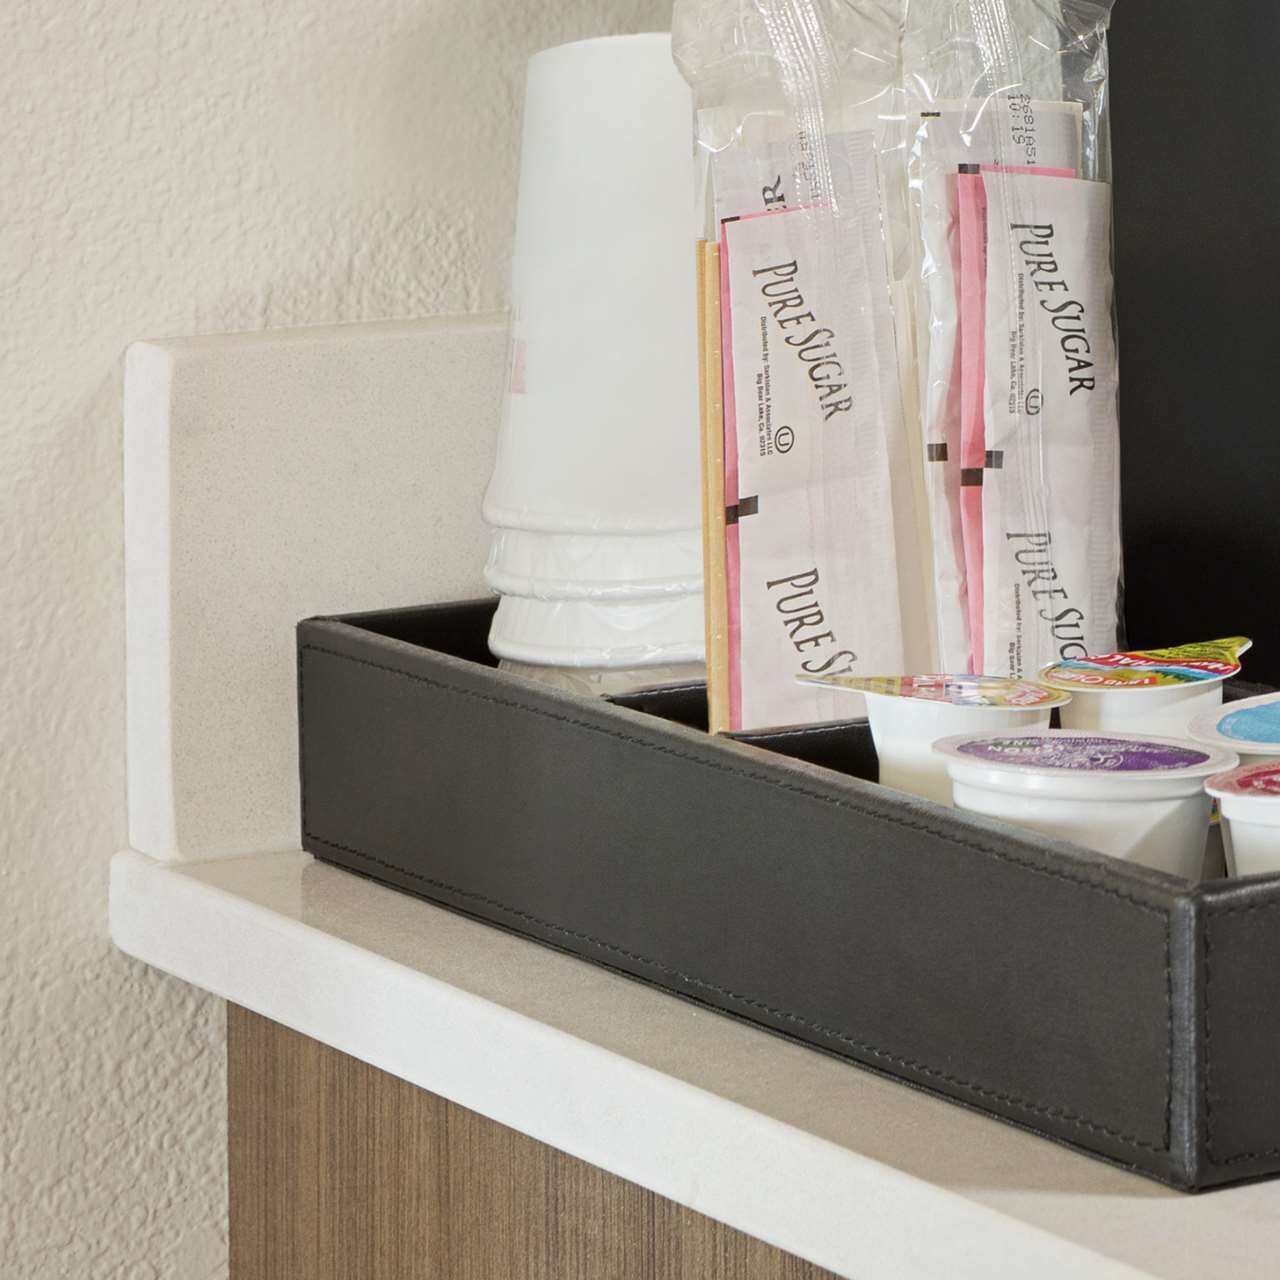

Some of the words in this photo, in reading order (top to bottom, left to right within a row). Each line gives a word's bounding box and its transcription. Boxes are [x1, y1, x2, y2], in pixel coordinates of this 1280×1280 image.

[1010, 222, 1070, 293] PURE
[752, 260, 817, 330] PURE
[785, 327, 853, 422] SUGAR
[1039, 299, 1096, 397] SUGAR
[766, 442, 774, 456] LLC
[1006, 531, 1069, 601] PURE
[766, 567, 834, 654] PURE
